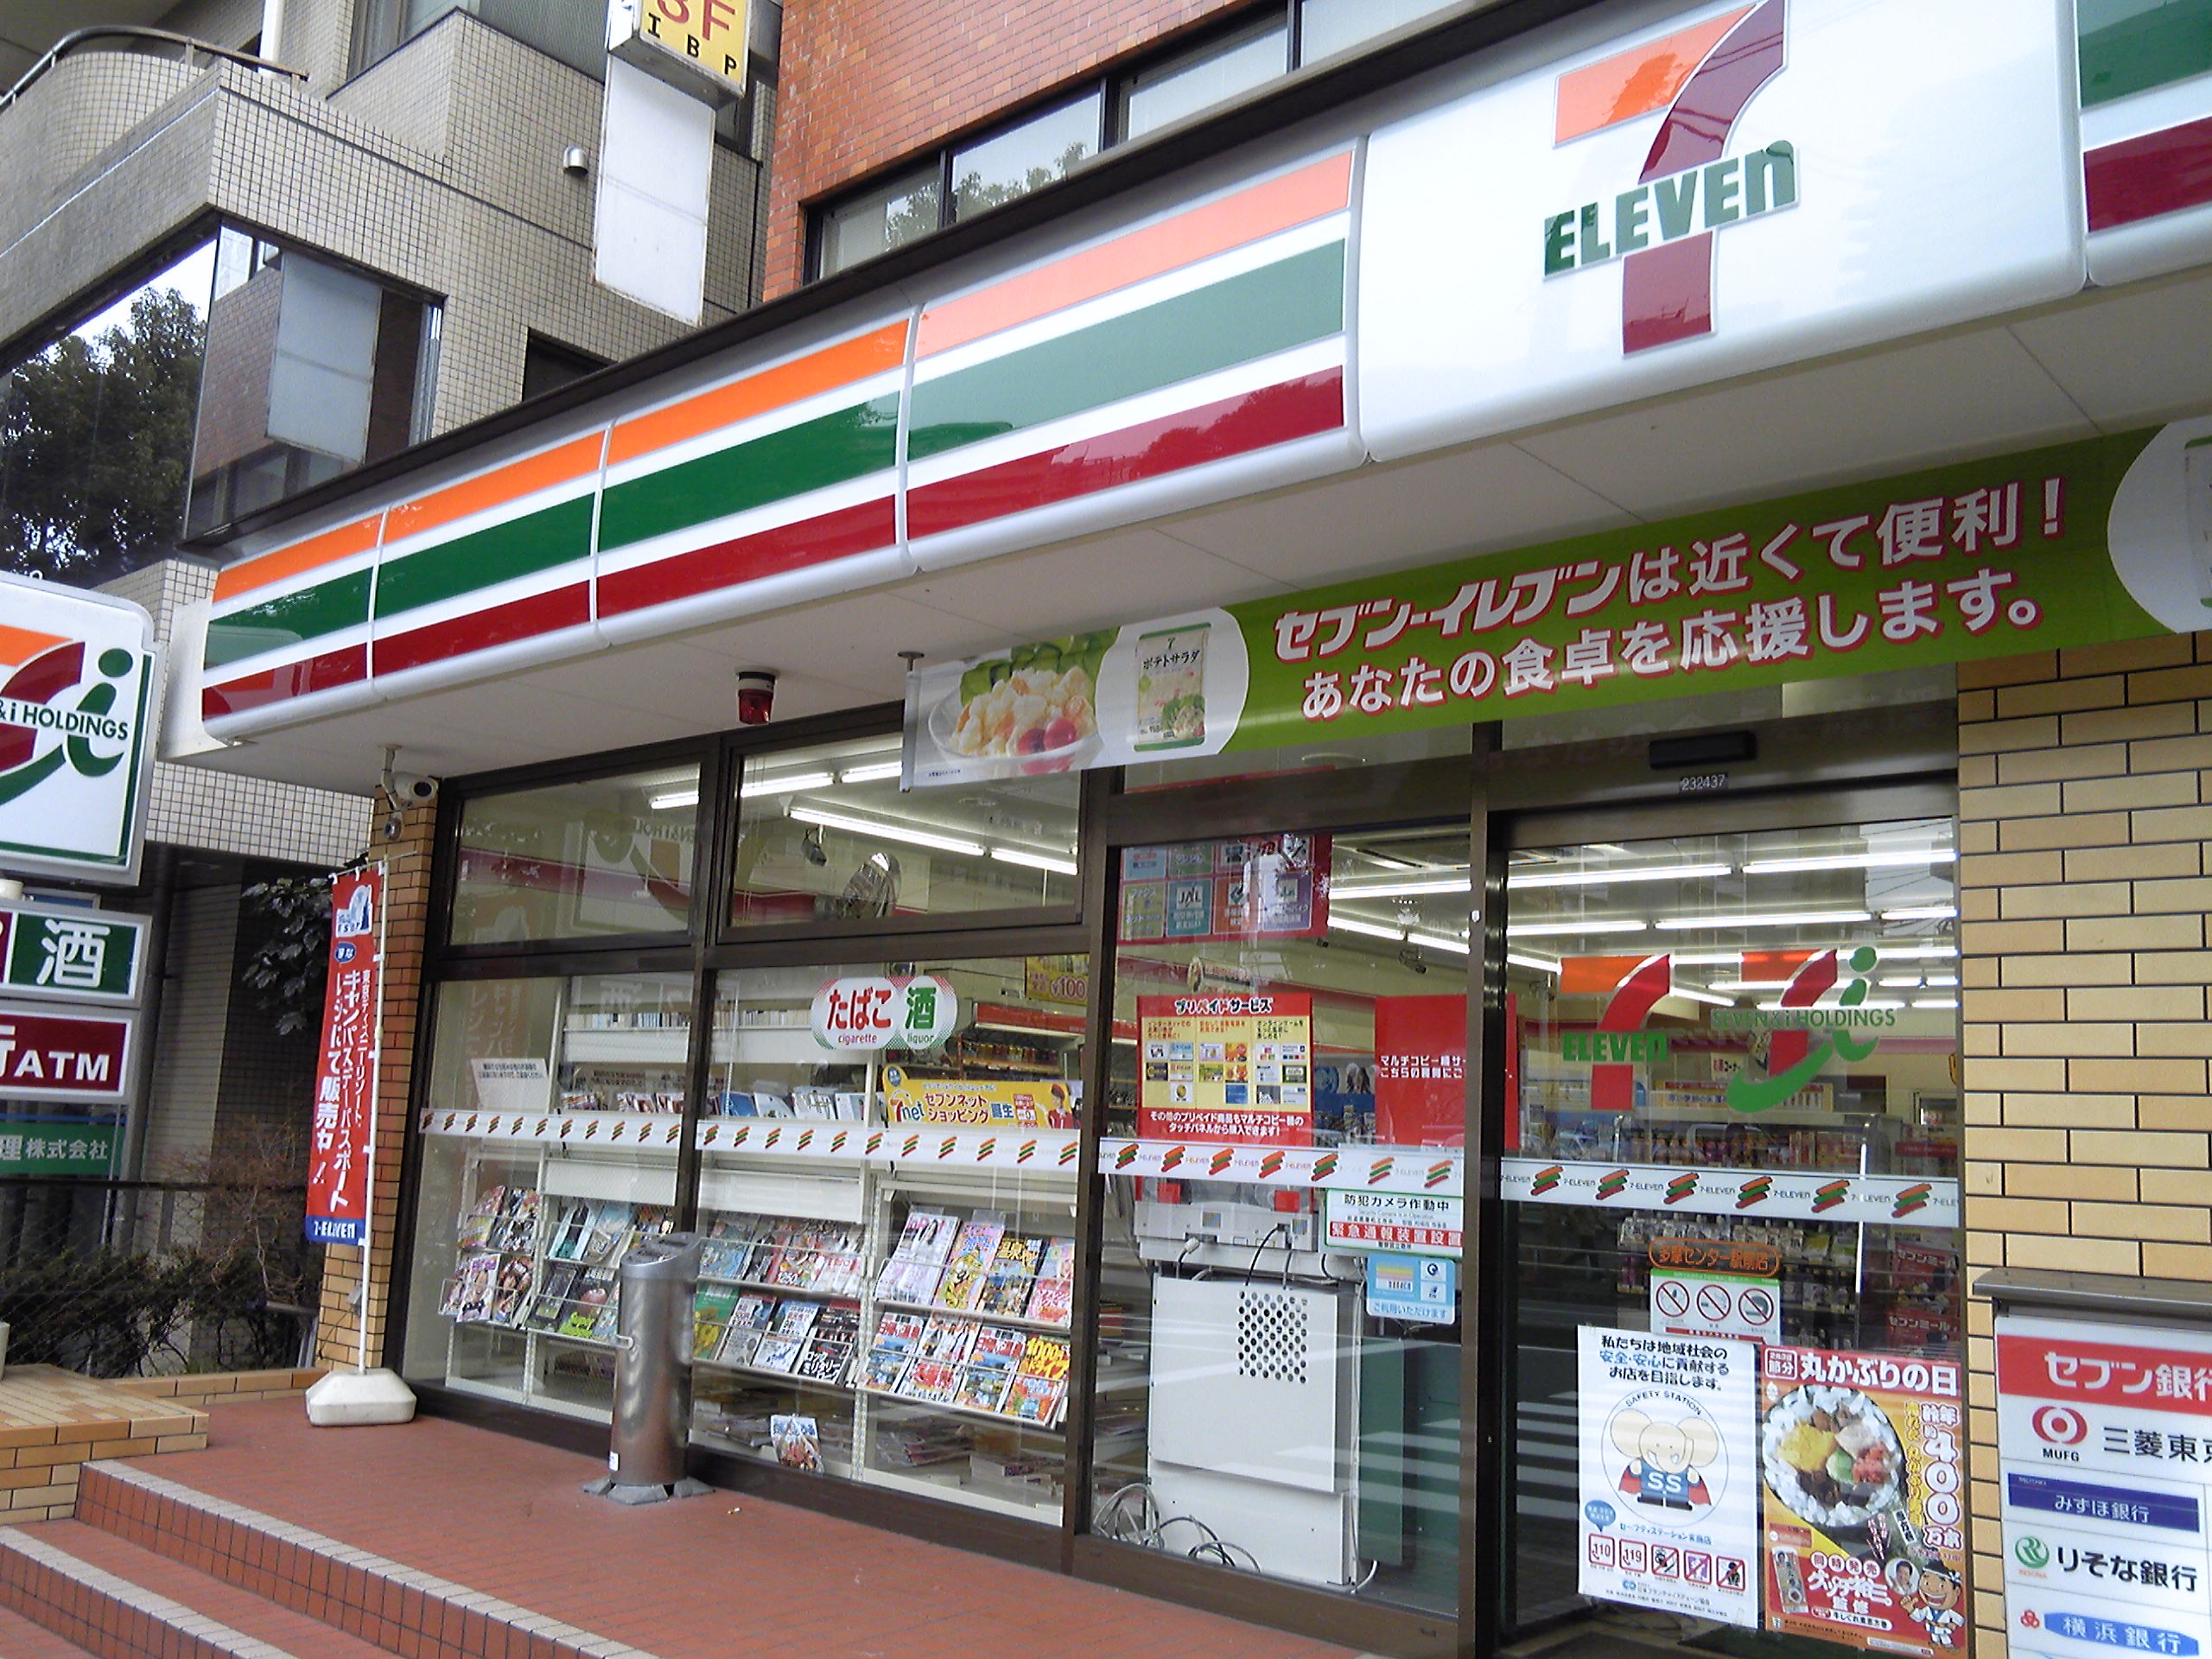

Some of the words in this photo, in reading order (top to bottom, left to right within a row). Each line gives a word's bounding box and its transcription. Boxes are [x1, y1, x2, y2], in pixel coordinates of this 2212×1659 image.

[1302, 569, 2041, 722] あなたの食卓を応援します。
[1143, 650, 1200, 669] ポテトサラダ
[22, 704, 129, 741] HOLDINGS
[1681, 774, 1726, 791] 232437
[36, 918, 111, 988] 酒
[827, 986, 893, 1031] たばこ
[904, 986, 938, 1031] 酒
[1175, 997, 1273, 1015] プリペイドサービス
[837, 1033, 878, 1046] cigarette
[906, 1032, 936, 1045] liquor
[1381, 1054, 1466, 1067] マルチコピー機サ
[925, 1091, 988, 1109] セブンネット
[928, 1107, 989, 1125] ショッピング
[1344, 1193, 1450, 1211] 防犯カメラ作動中
[1331, 1222, 1462, 1246] 緊急通報装置設置
[1601, 1335, 1727, 1360] 私たちは地域社会の
[1609, 1365, 1722, 1391] お店を目指します。
[1801, 1352, 1958, 1397] 丸かぶりの日
[1625, 1390, 1659, 1408] SAFETY
[1663, 1389, 1702, 1415] STATION
[2043, 1448, 2080, 1462] MUFG
[1647, 1471, 1682, 1493] SS
[2055, 1494, 2150, 1523] みずほ銀行
[1592, 1542, 1611, 1557] 110
[1624, 1548, 1643, 1563] 119
[1812, 1552, 1880, 1579] 同時発売
[2056, 1546, 2197, 1592] りそな銀行
[2063, 1615, 2182, 1654] 横浜銀行
